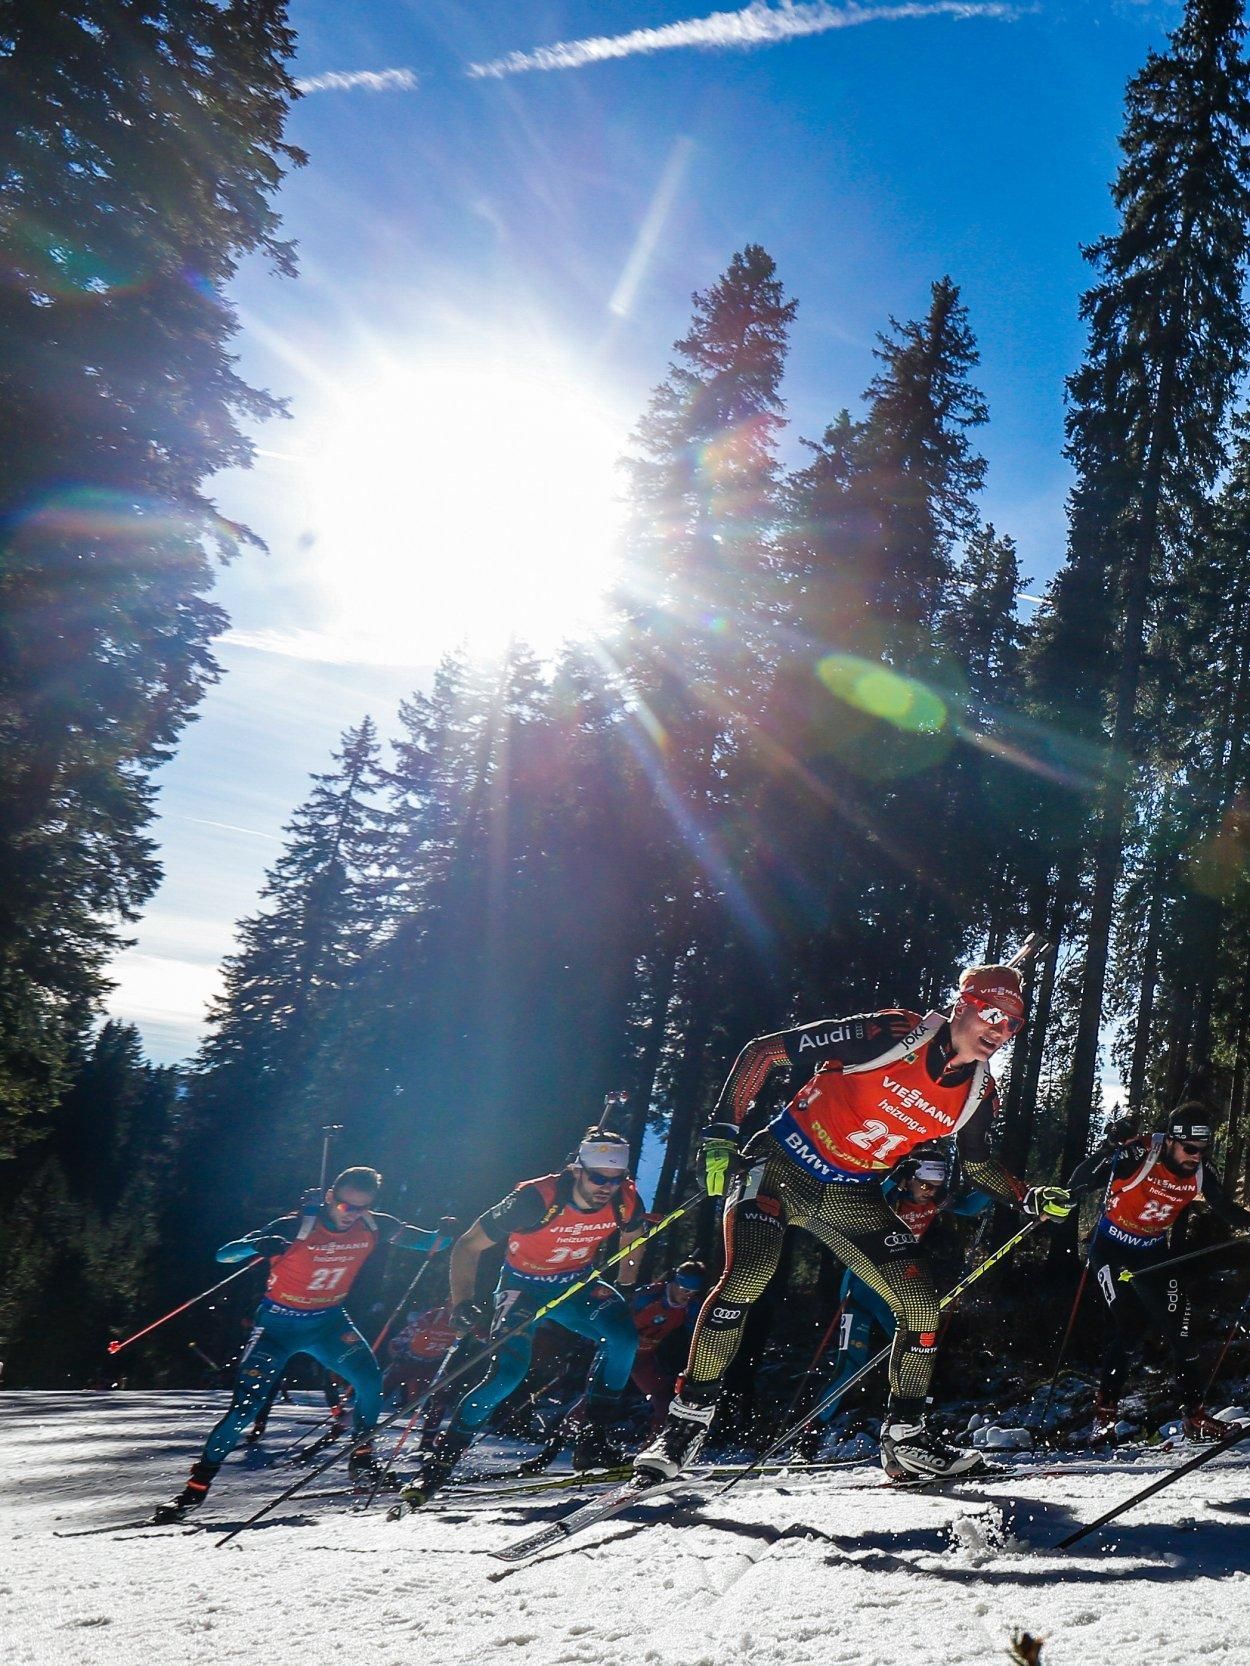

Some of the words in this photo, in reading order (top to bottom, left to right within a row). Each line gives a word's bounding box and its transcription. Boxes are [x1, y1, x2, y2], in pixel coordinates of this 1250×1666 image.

[798, 1025, 851, 1053] Audi
[900, 1023, 929, 1050] JOKA
[878, 1098, 927, 1135] heizung.de
[882, 1076, 955, 1128] VIESSMANN
[785, 1132, 831, 1175] BMW
[846, 1119, 908, 1160] 21
[1138, 1200, 1174, 1221] 24
[1108, 1225, 1142, 1246] BMW
[306, 1268, 347, 1291] 27
[1168, 1279, 1178, 1312] odlo
